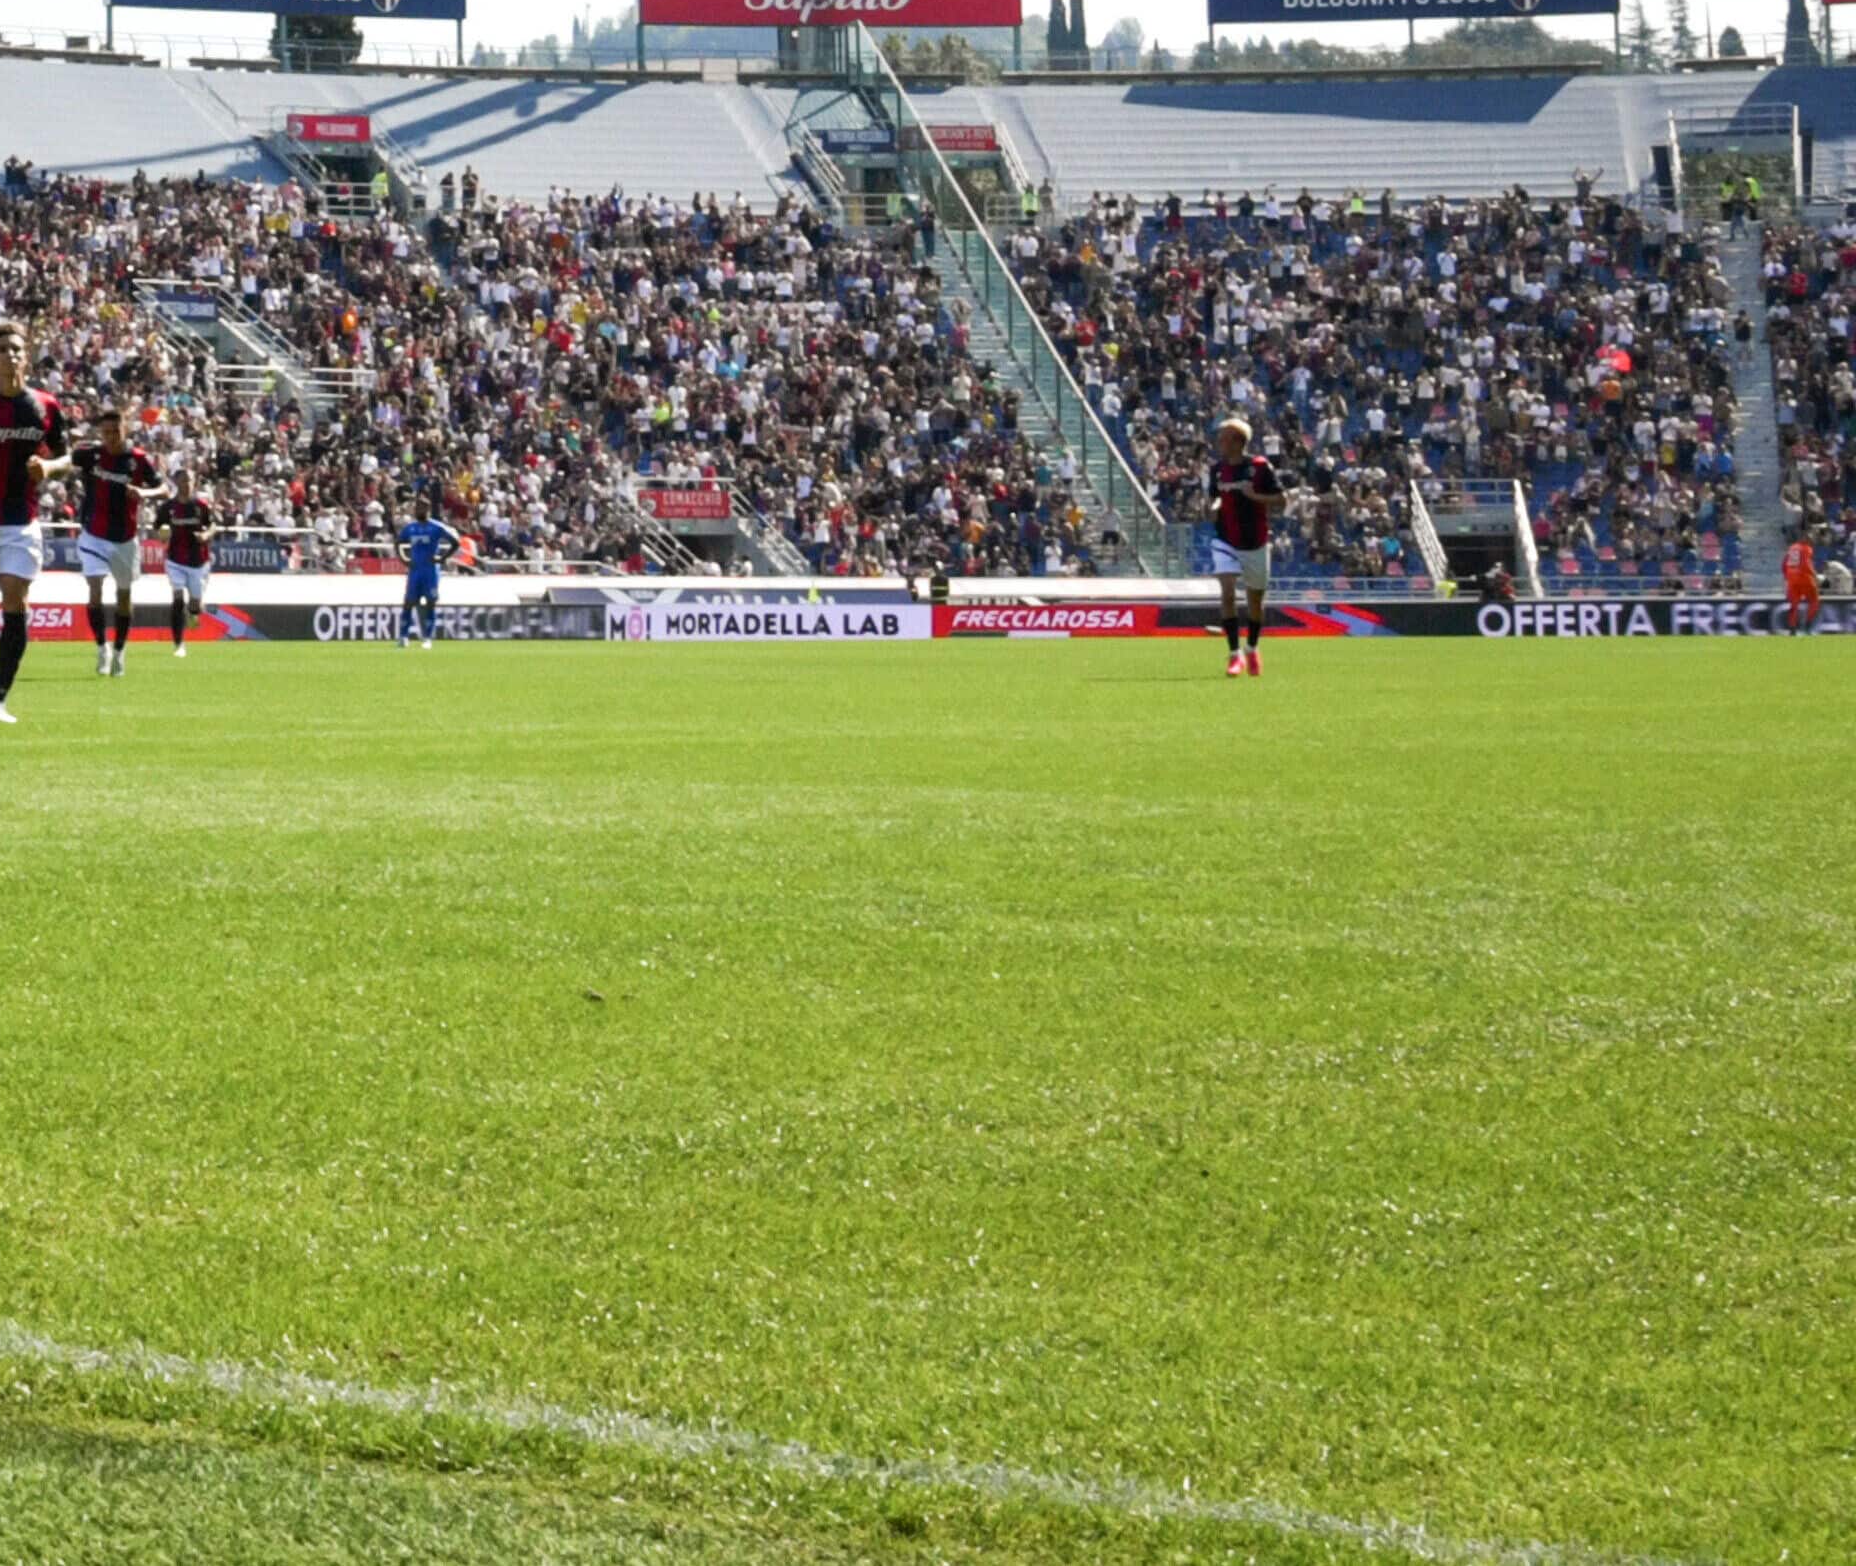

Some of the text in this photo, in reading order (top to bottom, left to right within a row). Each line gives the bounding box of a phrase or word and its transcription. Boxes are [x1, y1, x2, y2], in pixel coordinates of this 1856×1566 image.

[219, 548, 279, 567] SVIZZERA
[666, 613, 831, 635] MORTADELLA
[843, 614, 900, 635] LAB
[952, 610, 1134, 628] FRECCIAROSSA
[1477, 603, 1656, 636] OFFERTA
